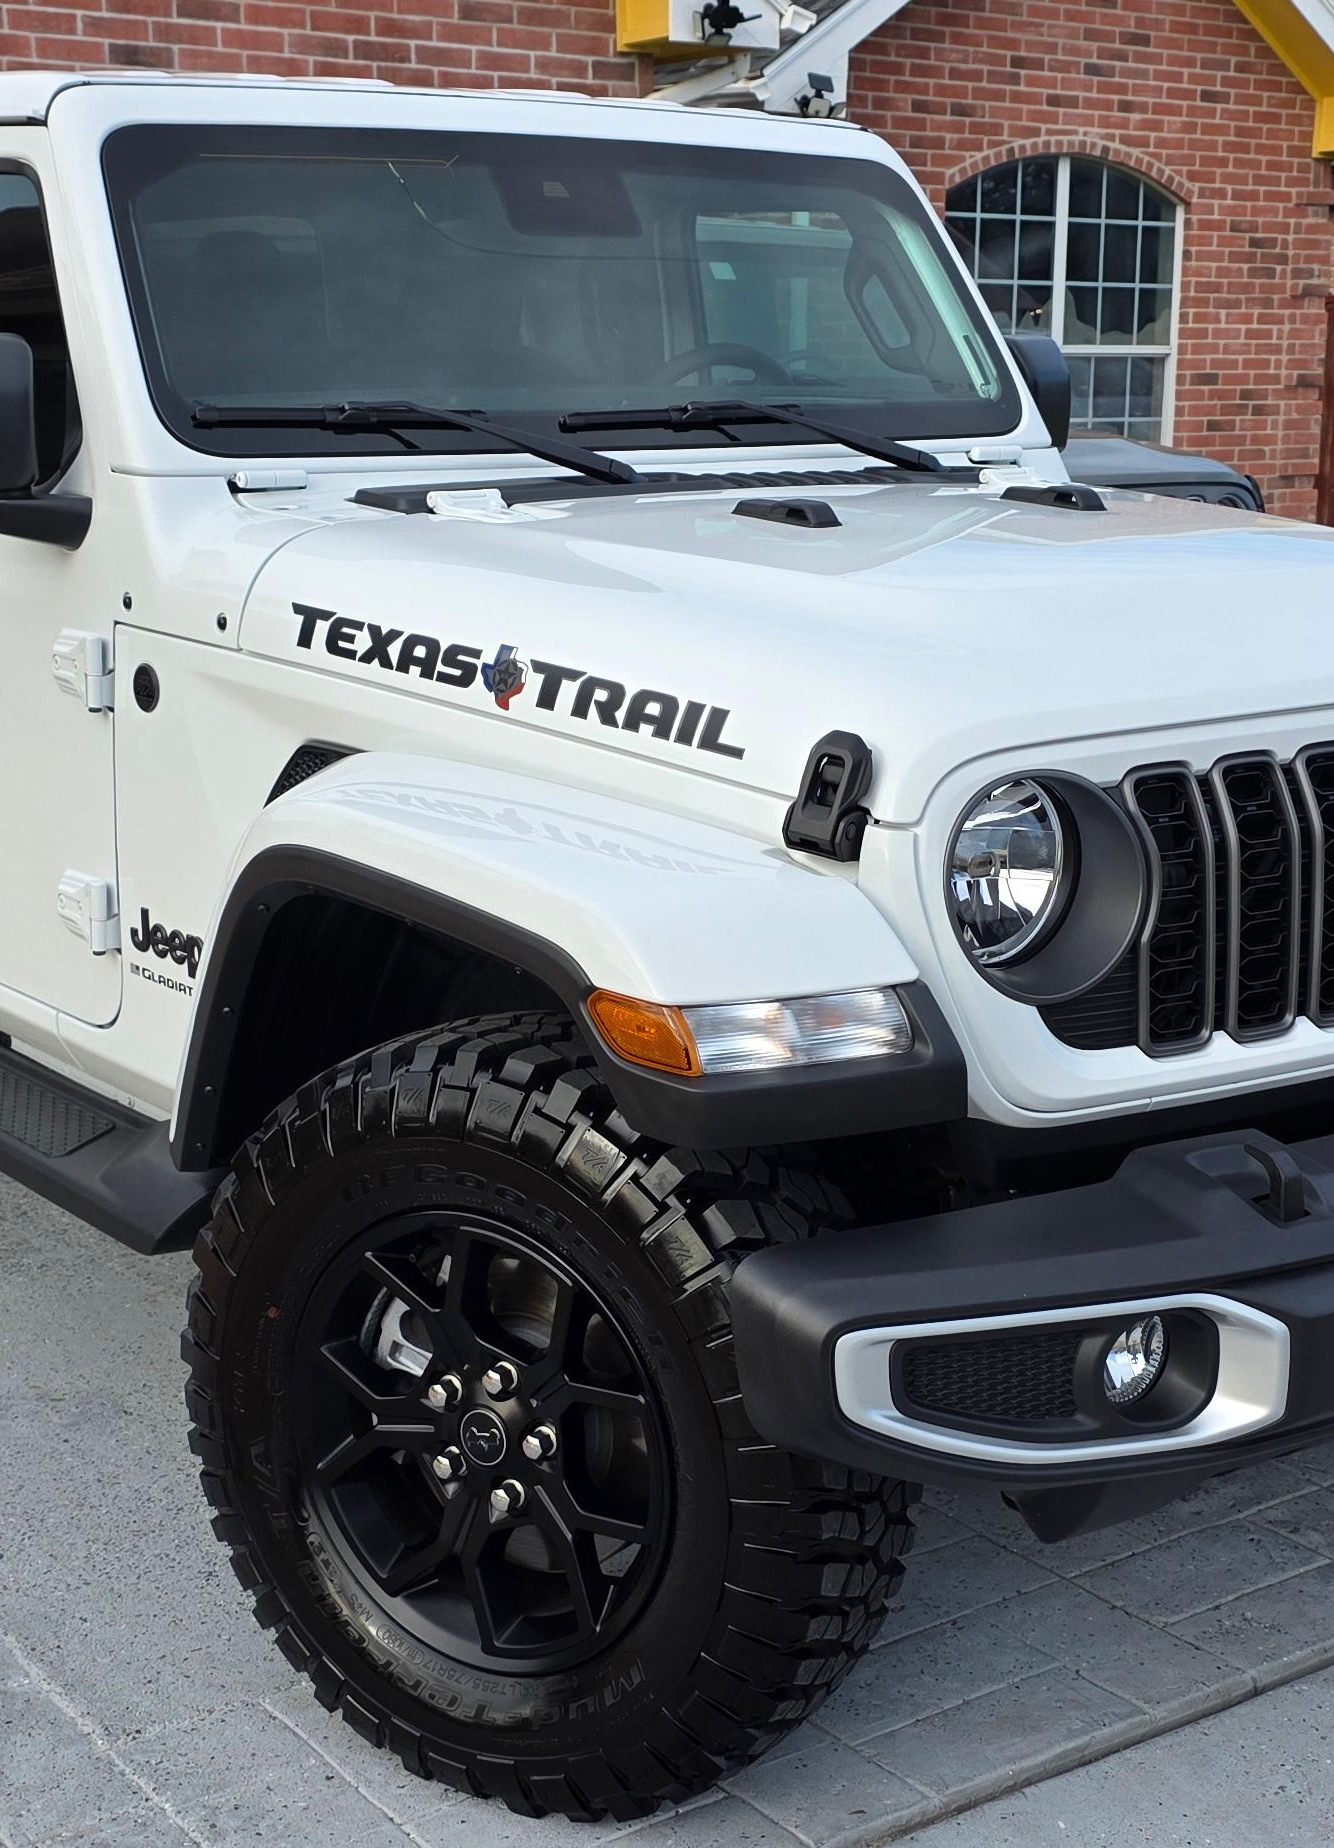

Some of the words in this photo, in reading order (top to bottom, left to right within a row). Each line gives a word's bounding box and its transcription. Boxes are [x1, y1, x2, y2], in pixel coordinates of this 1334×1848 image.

[292, 602, 483, 688] TEXAS
[530, 658, 745, 760] TRAIL
[130, 907, 204, 979] Jeep
